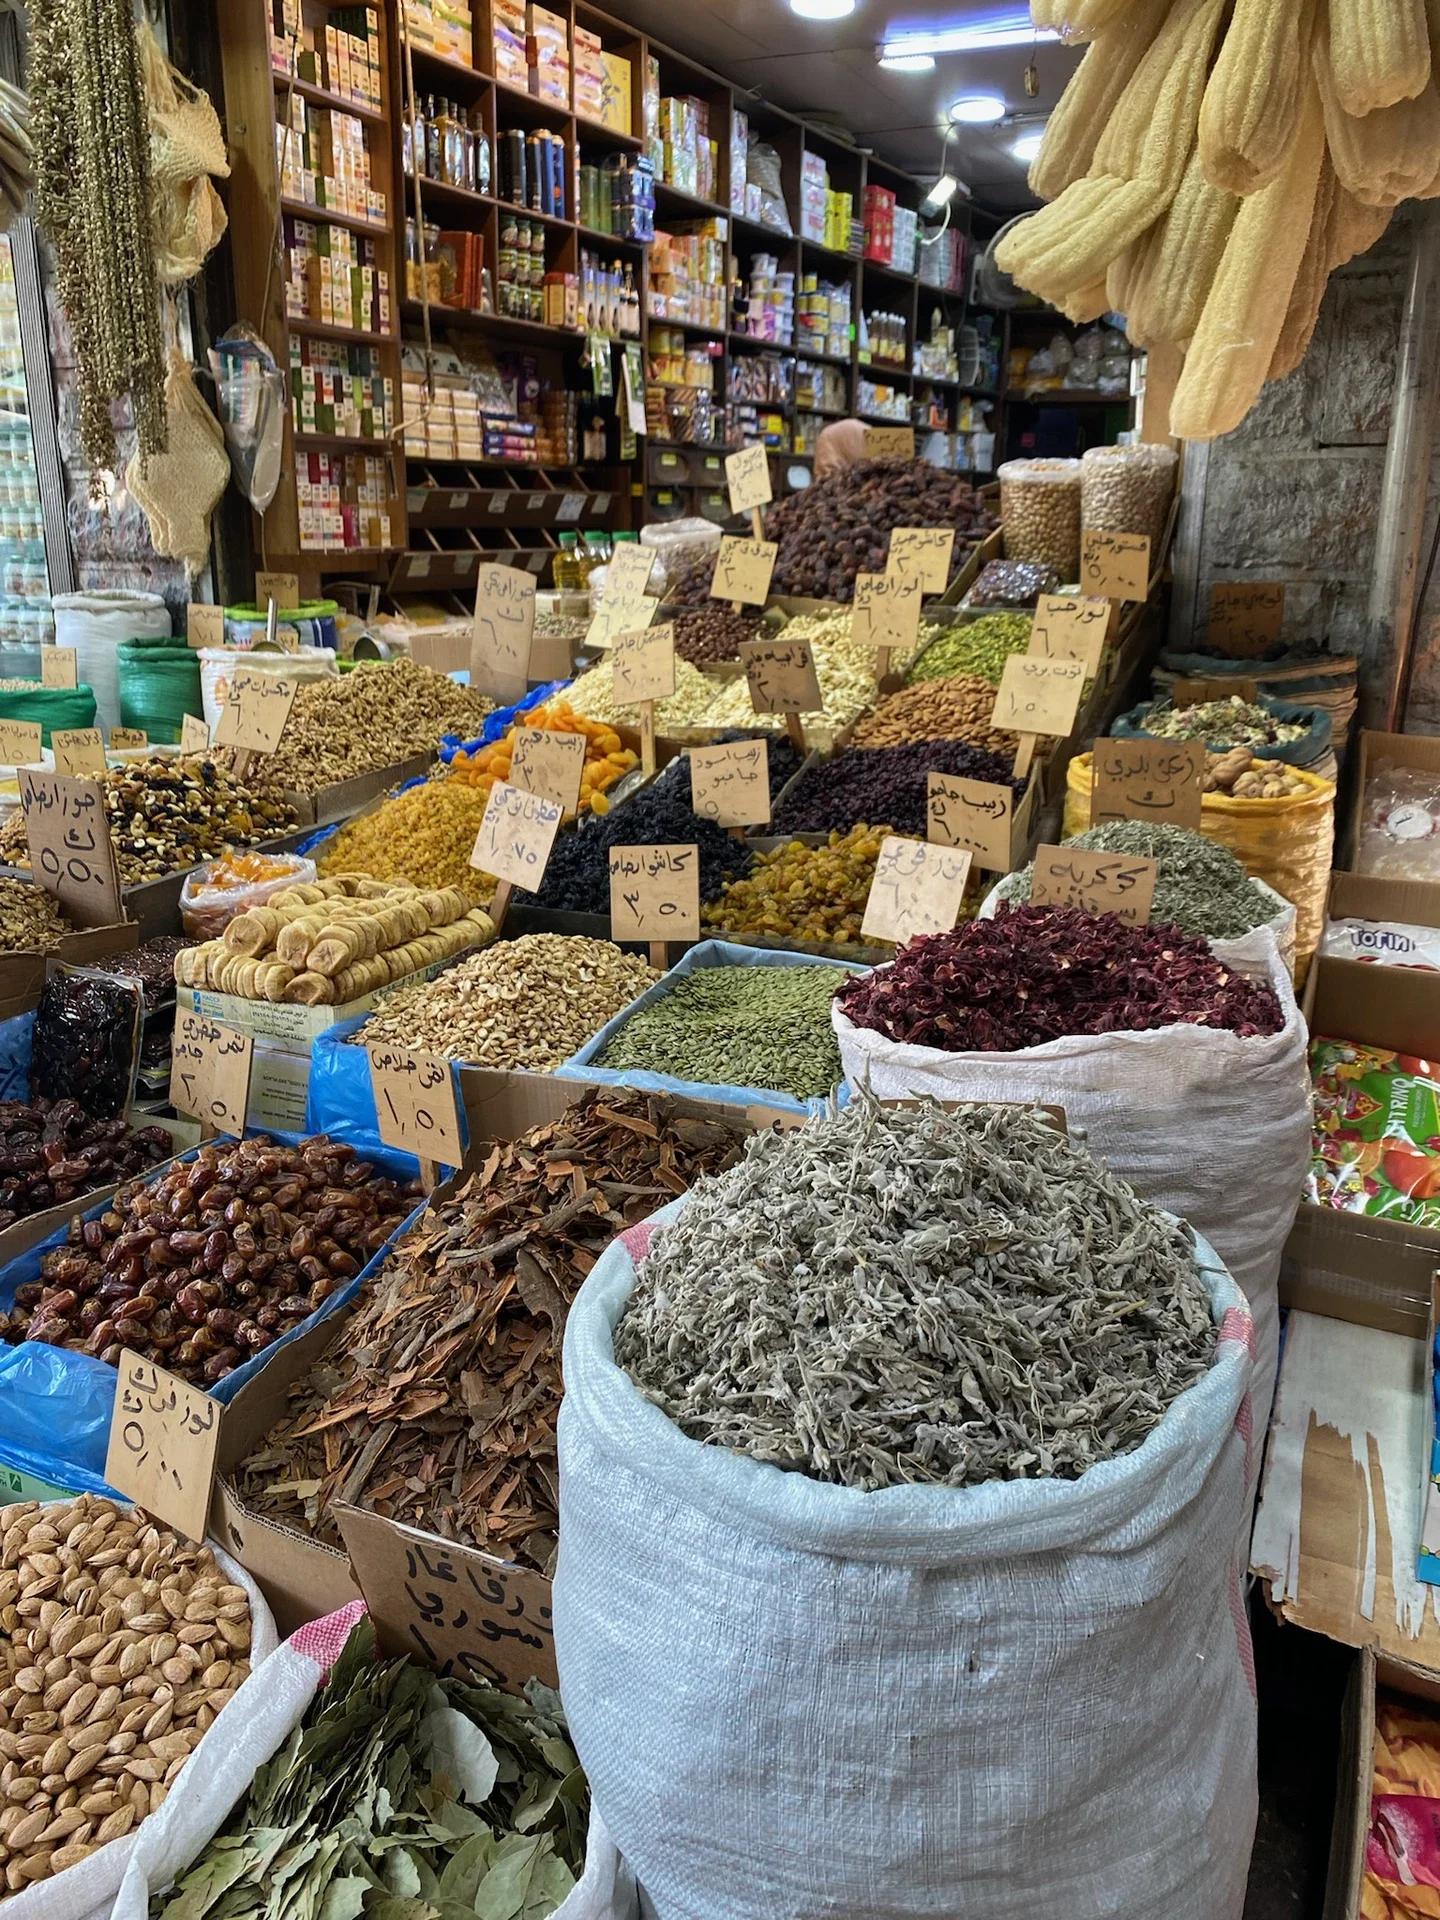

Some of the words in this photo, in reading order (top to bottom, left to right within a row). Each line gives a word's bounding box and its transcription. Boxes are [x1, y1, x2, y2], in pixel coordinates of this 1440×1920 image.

[892, 577, 920, 600] لوز
[1047, 602, 1077, 617] حب
[1075, 604, 1106, 625] لوز
[695, 750, 732, 769] اسود
[1104, 754, 1151, 782] بلدي
[60, 786, 97, 824] جوز
[962, 791, 1006, 818] زبيب
[648, 849, 693, 877] كاشو
[623, 890, 687, 928] ٣,٥٠
[217, 1033, 245, 1054] تمر
[372, 1048, 418, 1075] خلاص
[419, 1060, 446, 1089] تمر
[383, 1087, 447, 1138] ١,٥٠
[180, 1394, 214, 1435] لوز
[404, 1580, 543, 1648] سوري
